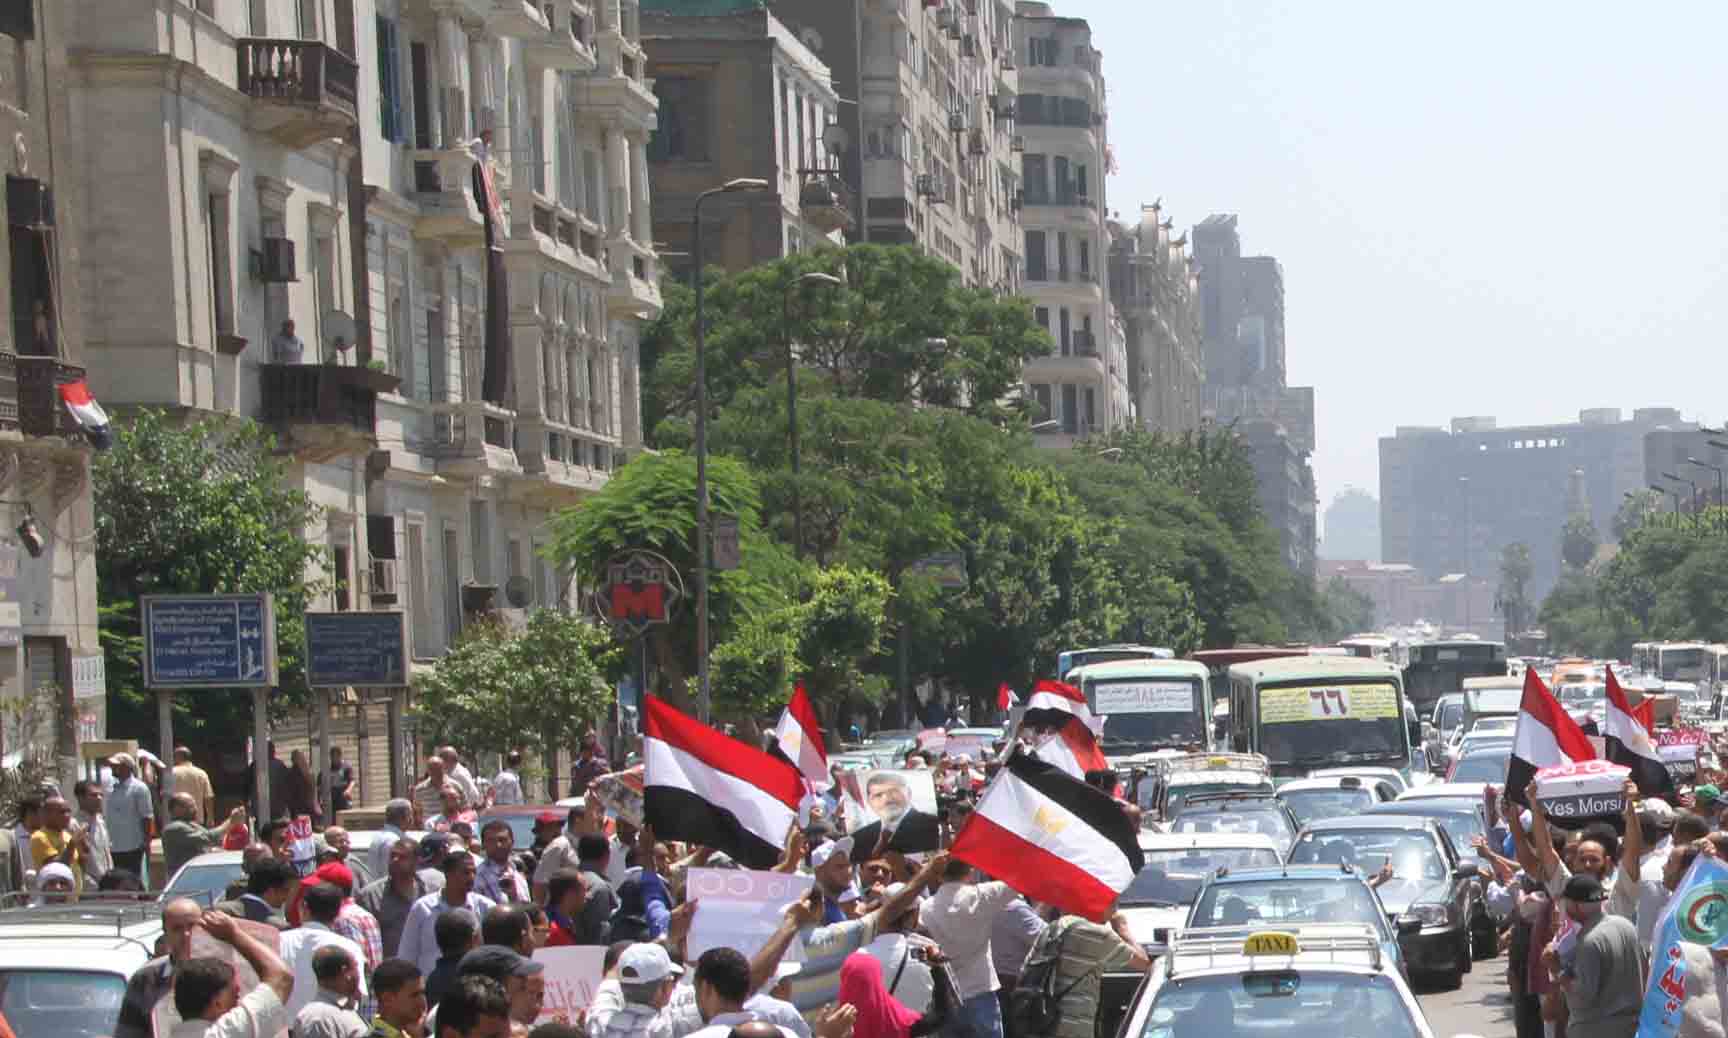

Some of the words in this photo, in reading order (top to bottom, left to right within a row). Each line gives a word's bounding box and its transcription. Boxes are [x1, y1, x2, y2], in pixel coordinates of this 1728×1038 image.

[1543, 800, 1575, 817] Yes
[1578, 794, 1622, 814] Morsi
[1250, 935, 1290, 953] TAXI
